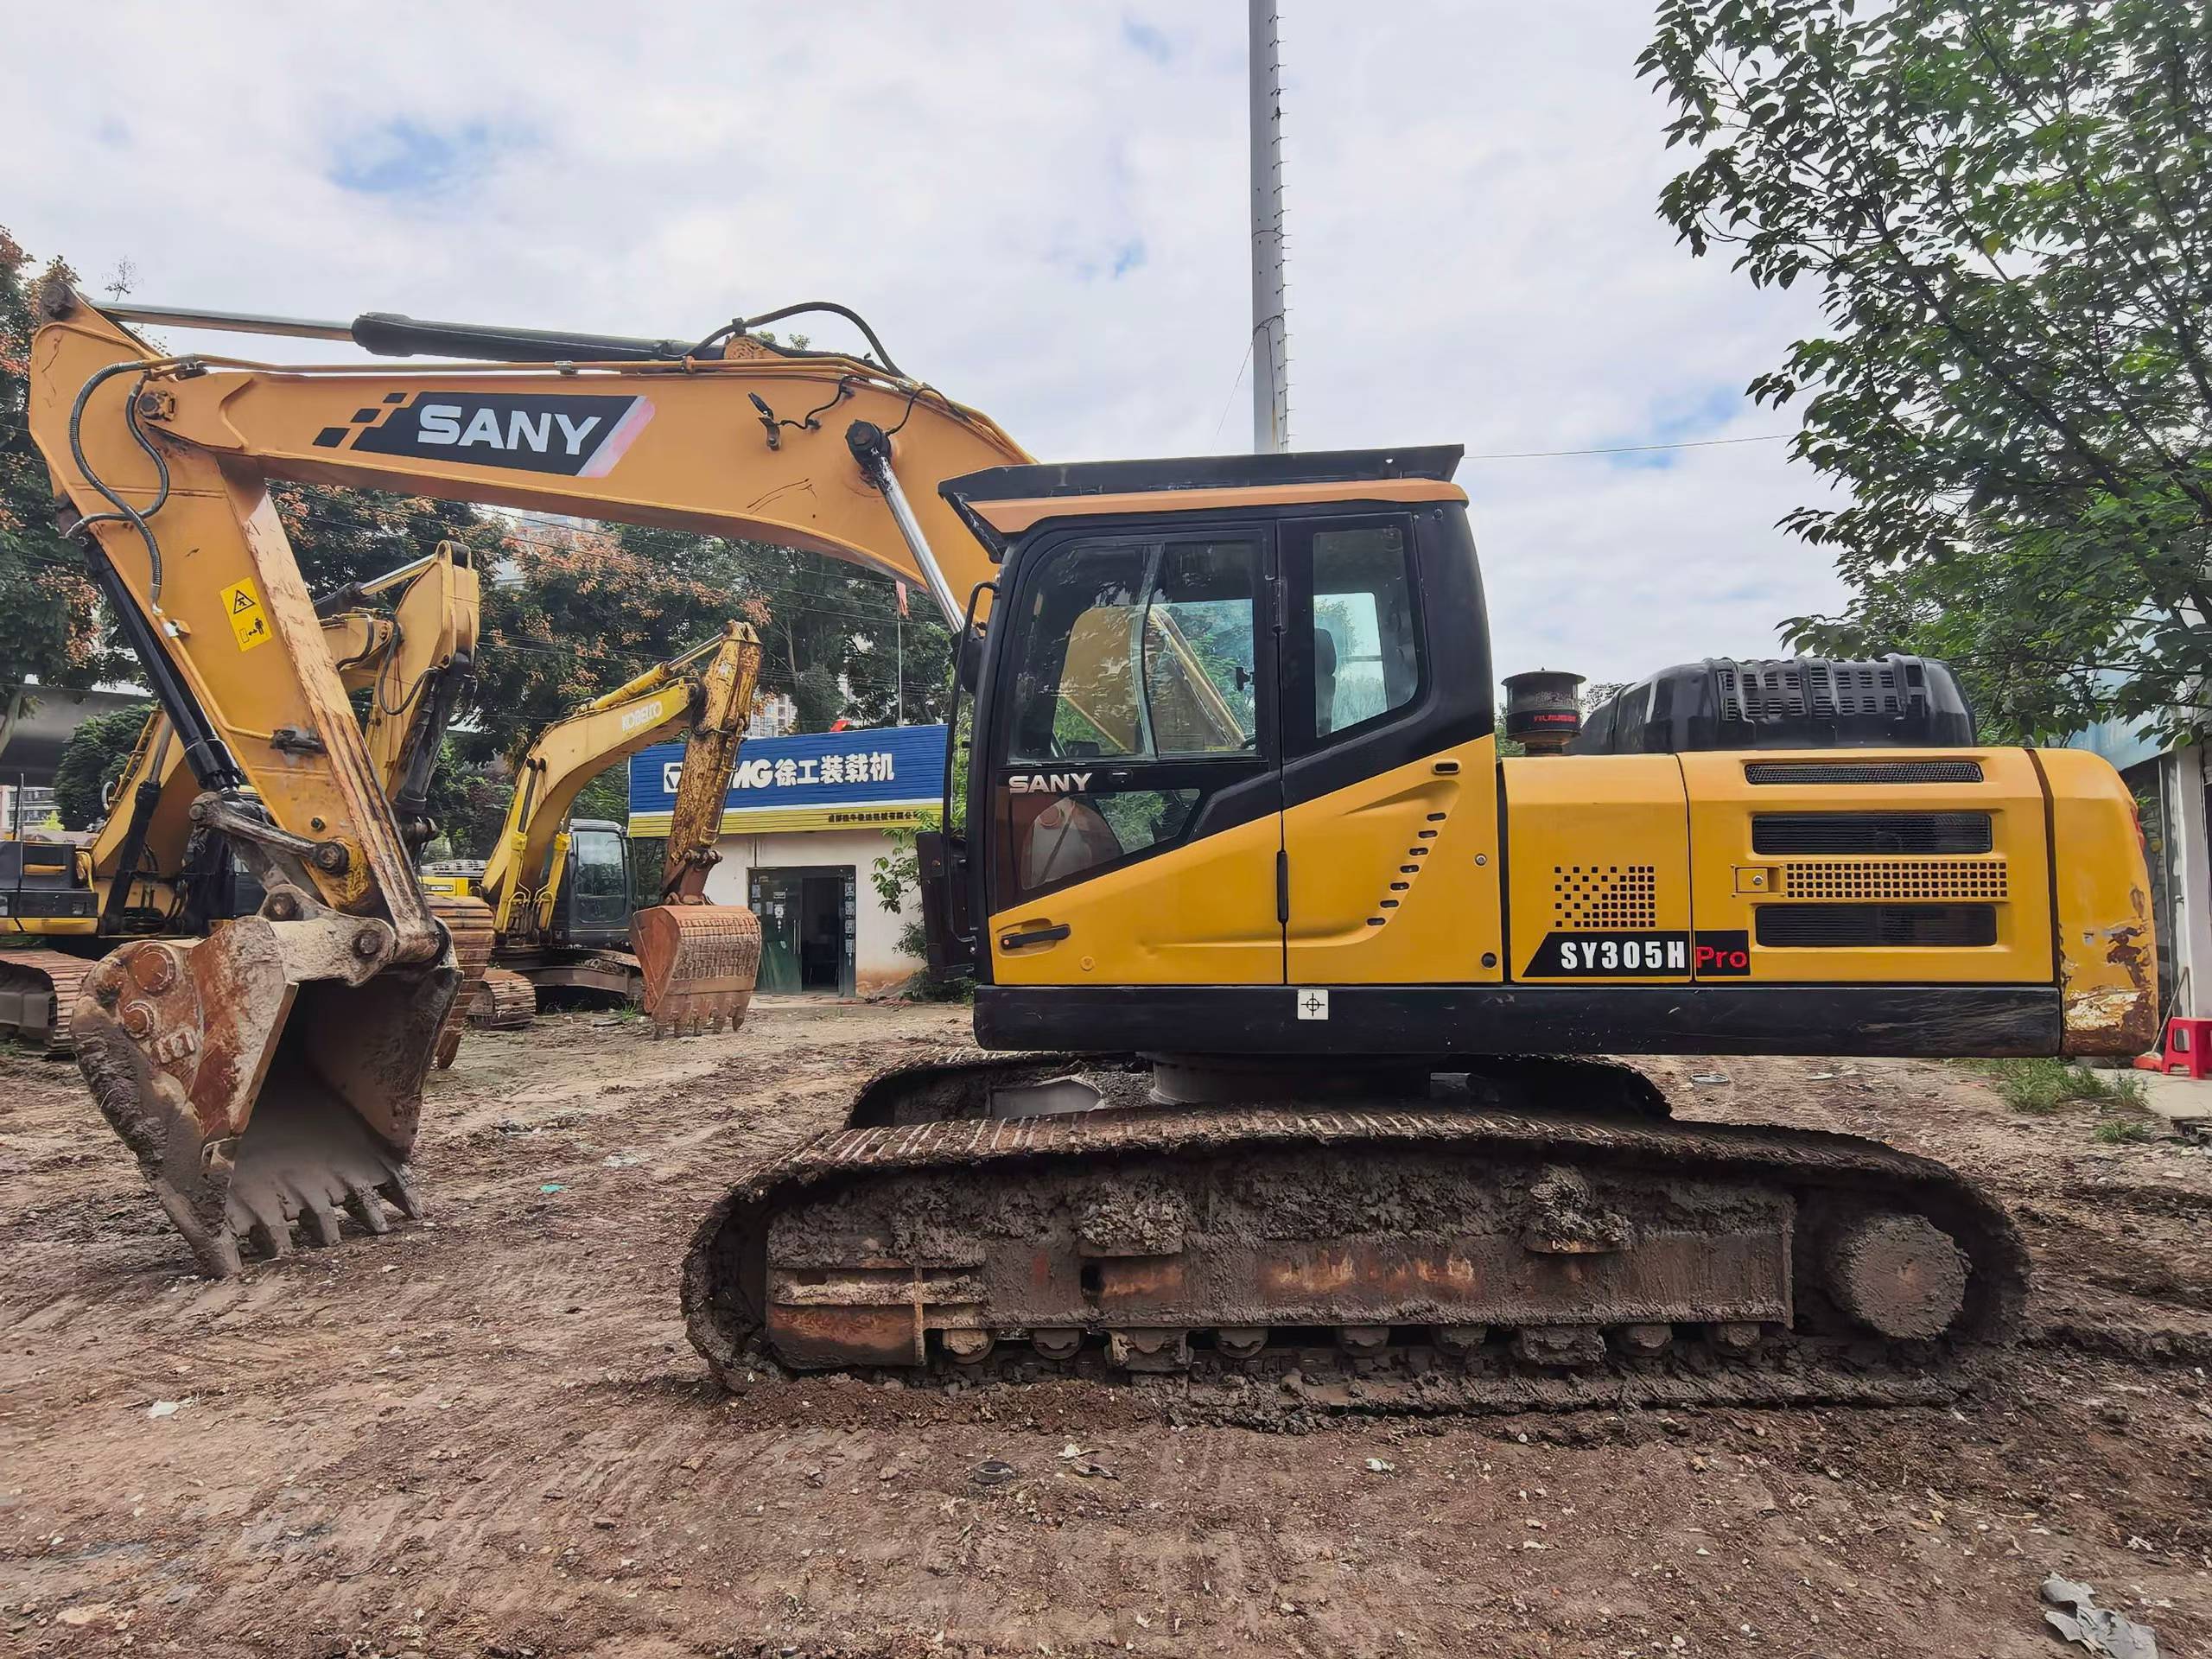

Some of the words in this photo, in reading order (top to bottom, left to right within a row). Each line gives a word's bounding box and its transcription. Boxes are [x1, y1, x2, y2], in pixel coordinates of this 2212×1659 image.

[417, 404, 602, 456] SANY
[774, 752, 895, 787] 徐工装载机
[1008, 772, 1092, 794] SANY
[1560, 941, 1685, 969] SY305H
[1696, 946, 1747, 968] Pro
